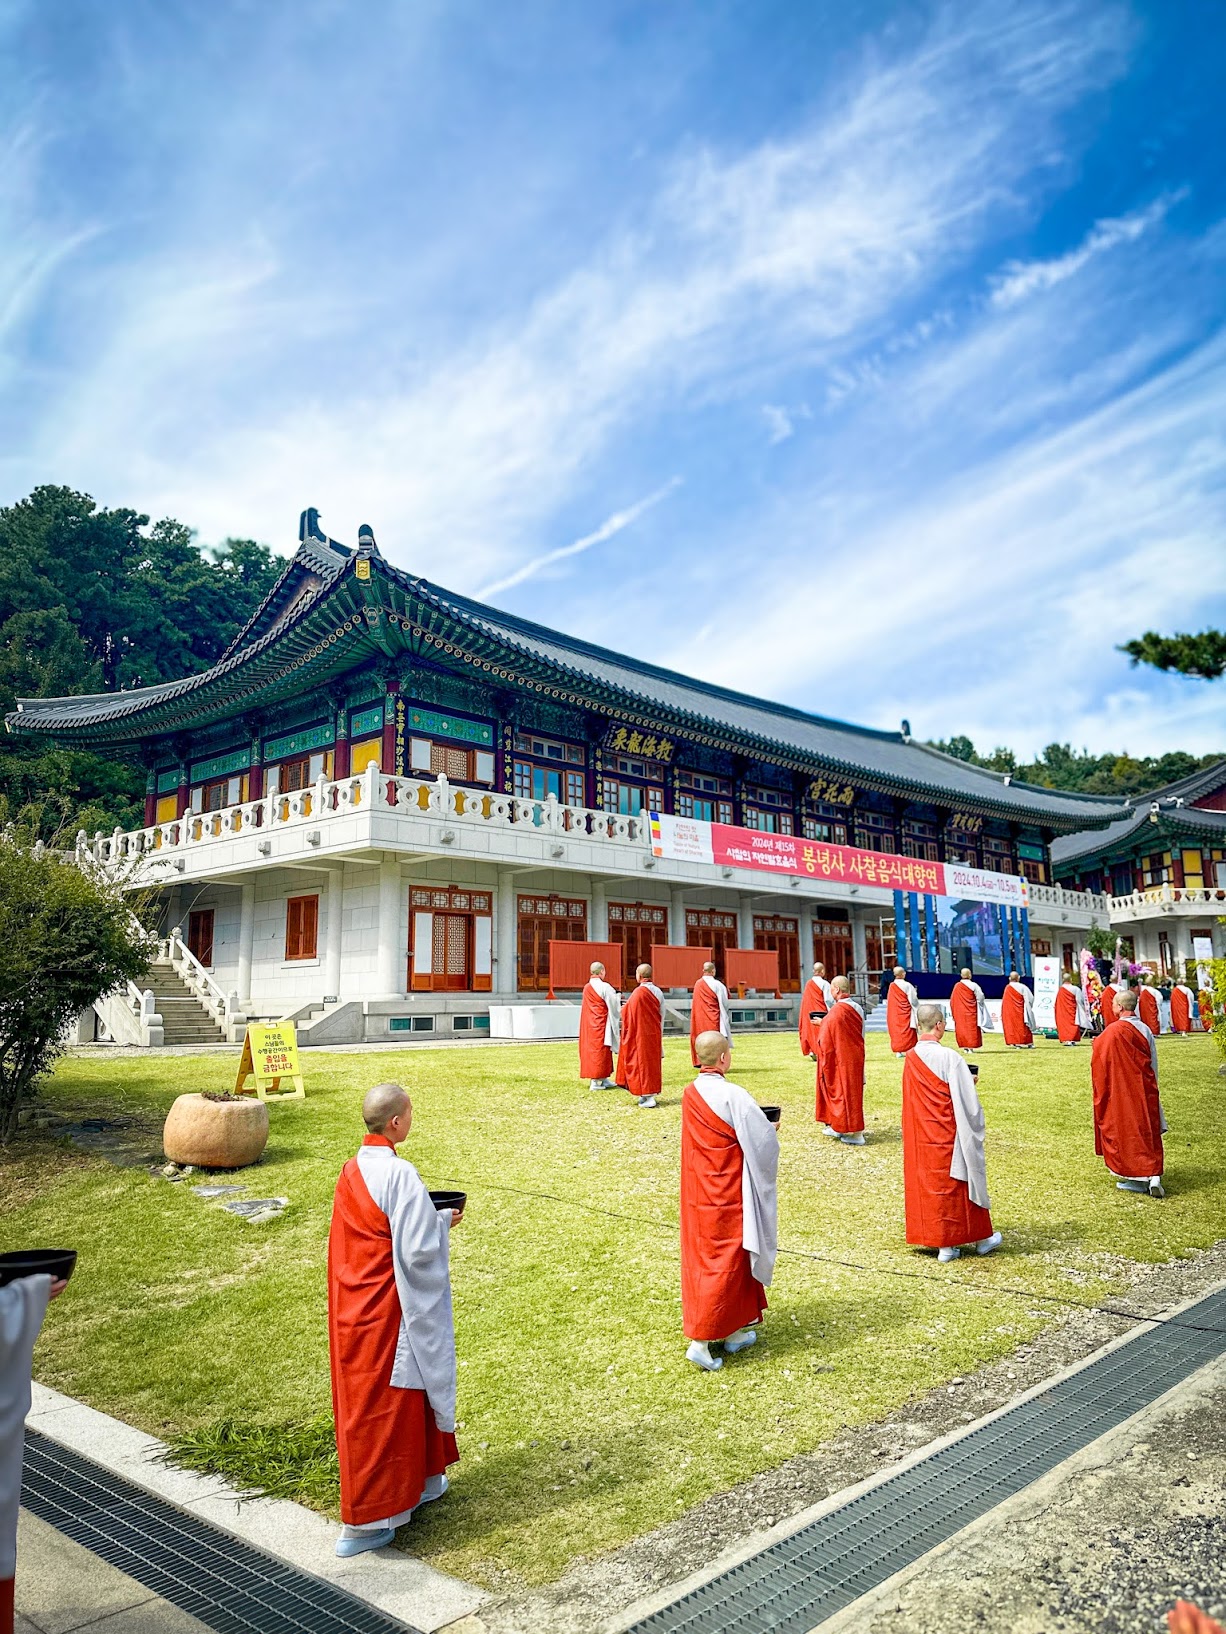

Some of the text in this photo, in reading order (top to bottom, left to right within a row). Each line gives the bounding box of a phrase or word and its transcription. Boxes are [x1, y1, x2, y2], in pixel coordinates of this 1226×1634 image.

[751, 836, 796, 855] 2024년 제15차
[801, 845, 939, 891] 봉녕사 사찰음식대향연
[266, 1053, 287, 1064] 출입을
[263, 1062, 293, 1073] 금합니다
